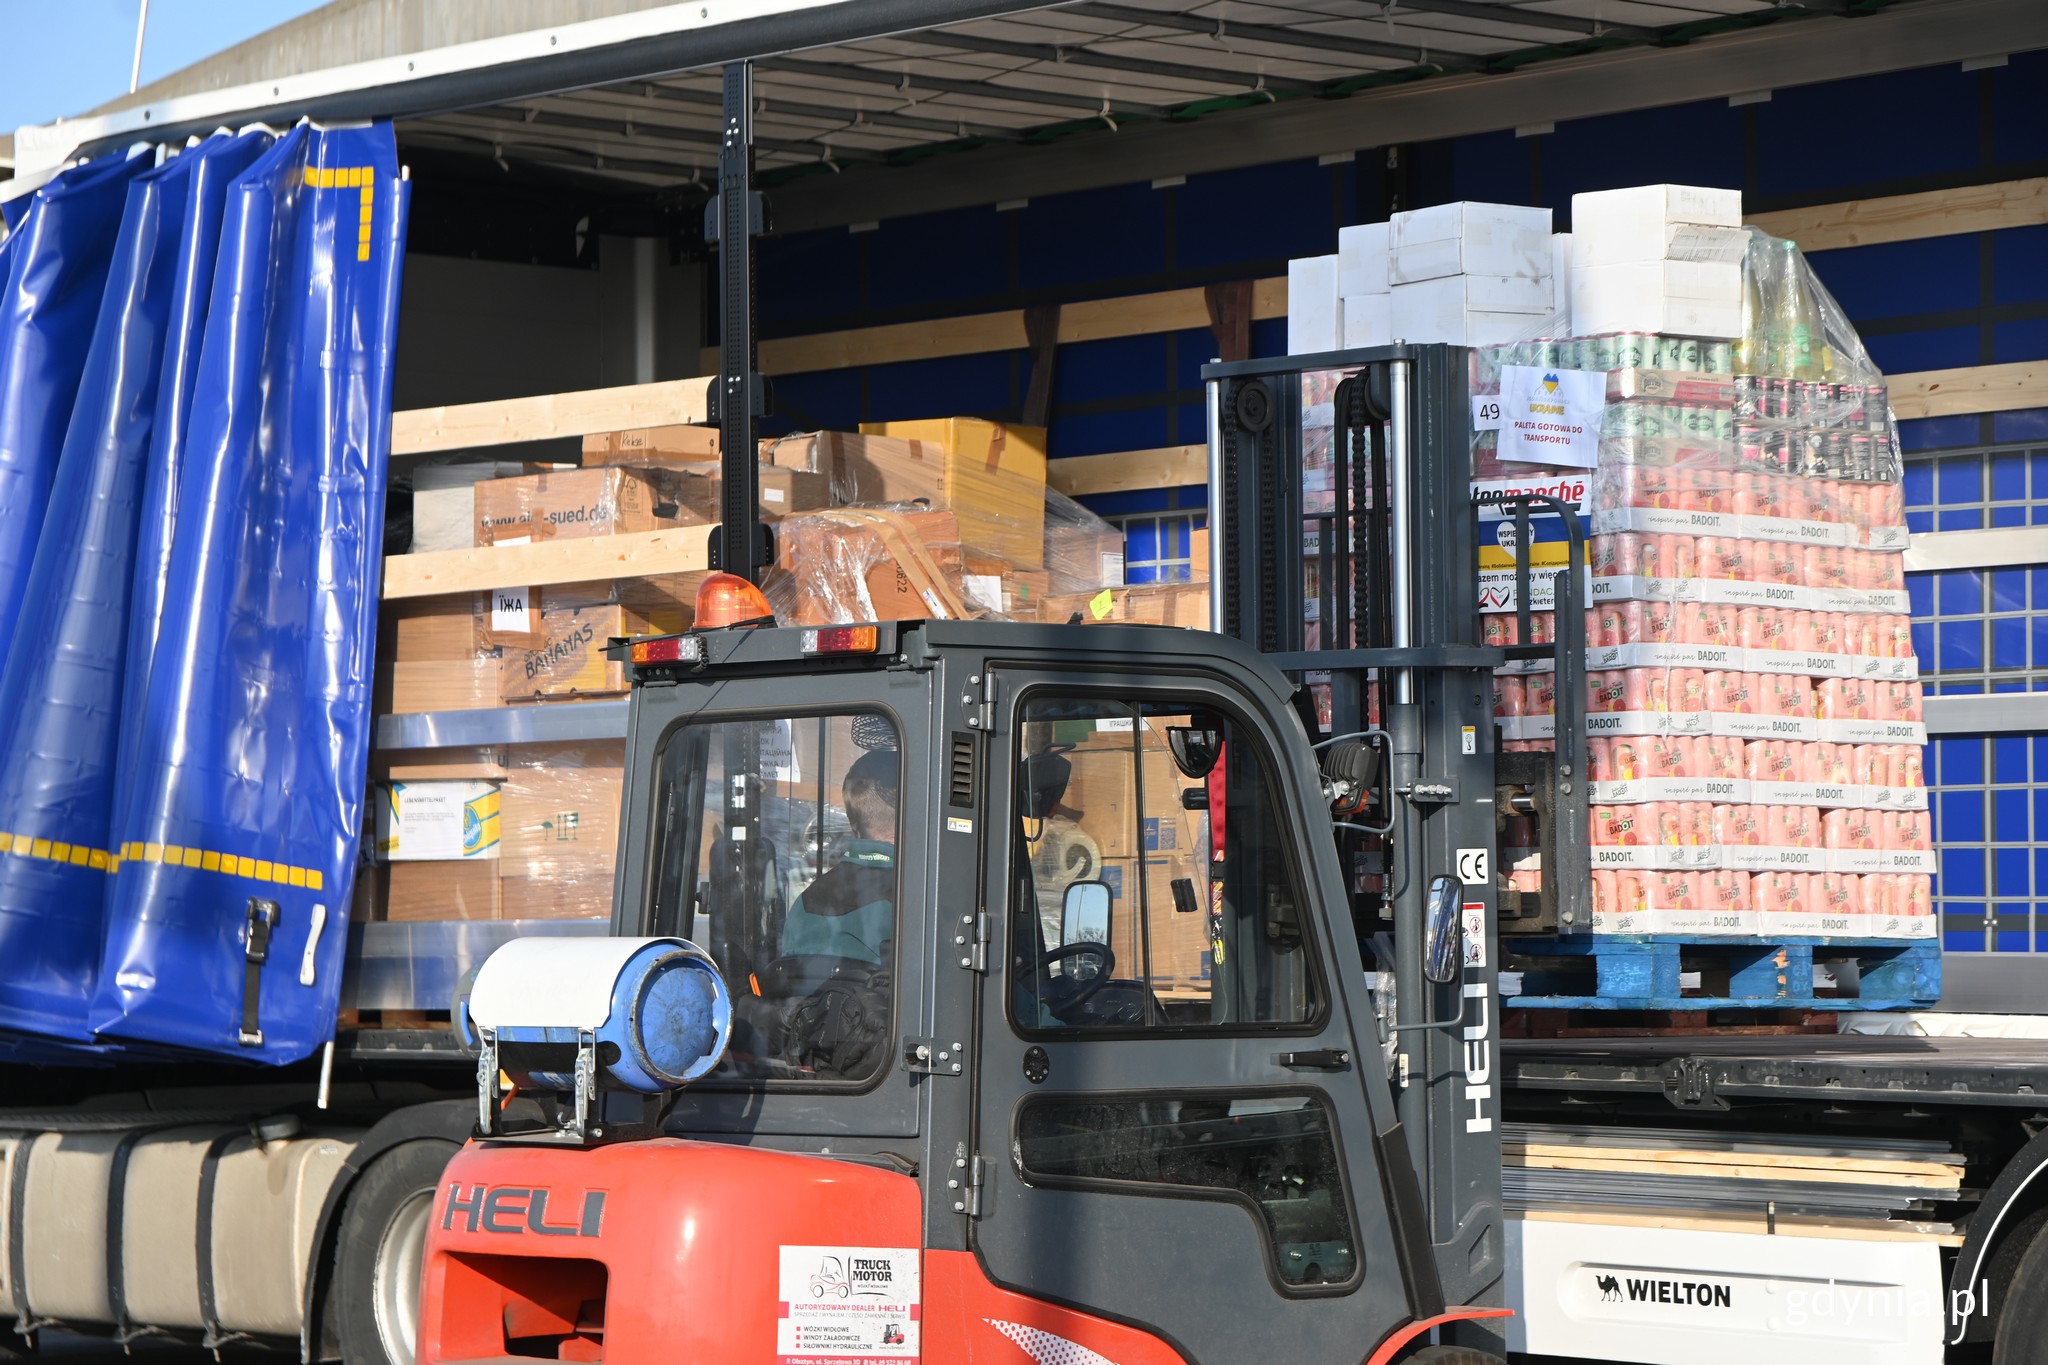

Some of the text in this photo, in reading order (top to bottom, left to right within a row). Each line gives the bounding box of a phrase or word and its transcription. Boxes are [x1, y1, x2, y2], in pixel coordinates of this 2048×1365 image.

[1479, 403, 1500, 420] 49
[1514, 421, 1583, 434] PALETA GOTOWA DO
[1523, 434, 1571, 445] TRANSPORTU
[1691, 514, 1721, 527] BADOIT.
[1498, 529, 1535, 538] WSPIEY
[1766, 588, 1796, 600] BADOIT.
[500, 595, 523, 613] ЇЖА
[525, 623, 593, 680] BANANAS
[1697, 651, 1727, 662] BADOIT.
[1807, 658, 1836, 669] BADOIT.
[1600, 687, 1624, 703] BADOIT
[1727, 690, 1749, 703] BADOIT
[1846, 694, 1866, 707] BADOIT
[1780, 696, 1801, 709] BADOIT
[1894, 699, 1914, 711] BADOIT
[1588, 718, 1622, 729] BADOIT.
[1772, 721, 1802, 733] BADOIT.
[1887, 726, 1914, 737] BADOIT.
[1661, 753, 1682, 769] BADOIT
[1771, 758, 1792, 772] BADOIT
[1706, 784, 1735, 795] BADOIT.
[1815, 788, 1844, 800] BADOIT.
[1609, 820, 1634, 834] BADOIT
[1735, 820, 1756, 833] BADOIT
[1850, 826, 1870, 840] BADOIT
[1599, 851, 1634, 862] BADOIT.
[1780, 853, 1809, 864] BADOIT.
[1894, 856, 1922, 866] BADOIT.
[1459, 852, 1485, 879] CE
[1667, 886, 1689, 899] BADOIT
[1719, 888, 1740, 902] BADOIT
[1779, 888, 1799, 902] BADOIT
[1829, 891, 1848, 904] BADOIT
[1714, 917, 1741, 927] BADOIT.
[1463, 982, 1492, 1133] HELI
[442, 1183, 606, 1238] HELI
[853, 1259, 891, 1270] TRUCK
[852, 1270, 893, 1282] MOTOR
[1626, 1278, 1731, 1308] WIELTON
[794, 1303, 906, 1312] AUTORYZOWANY DEALER HELI
[823, 1334, 860, 1342] ZAŁADOWCZE
